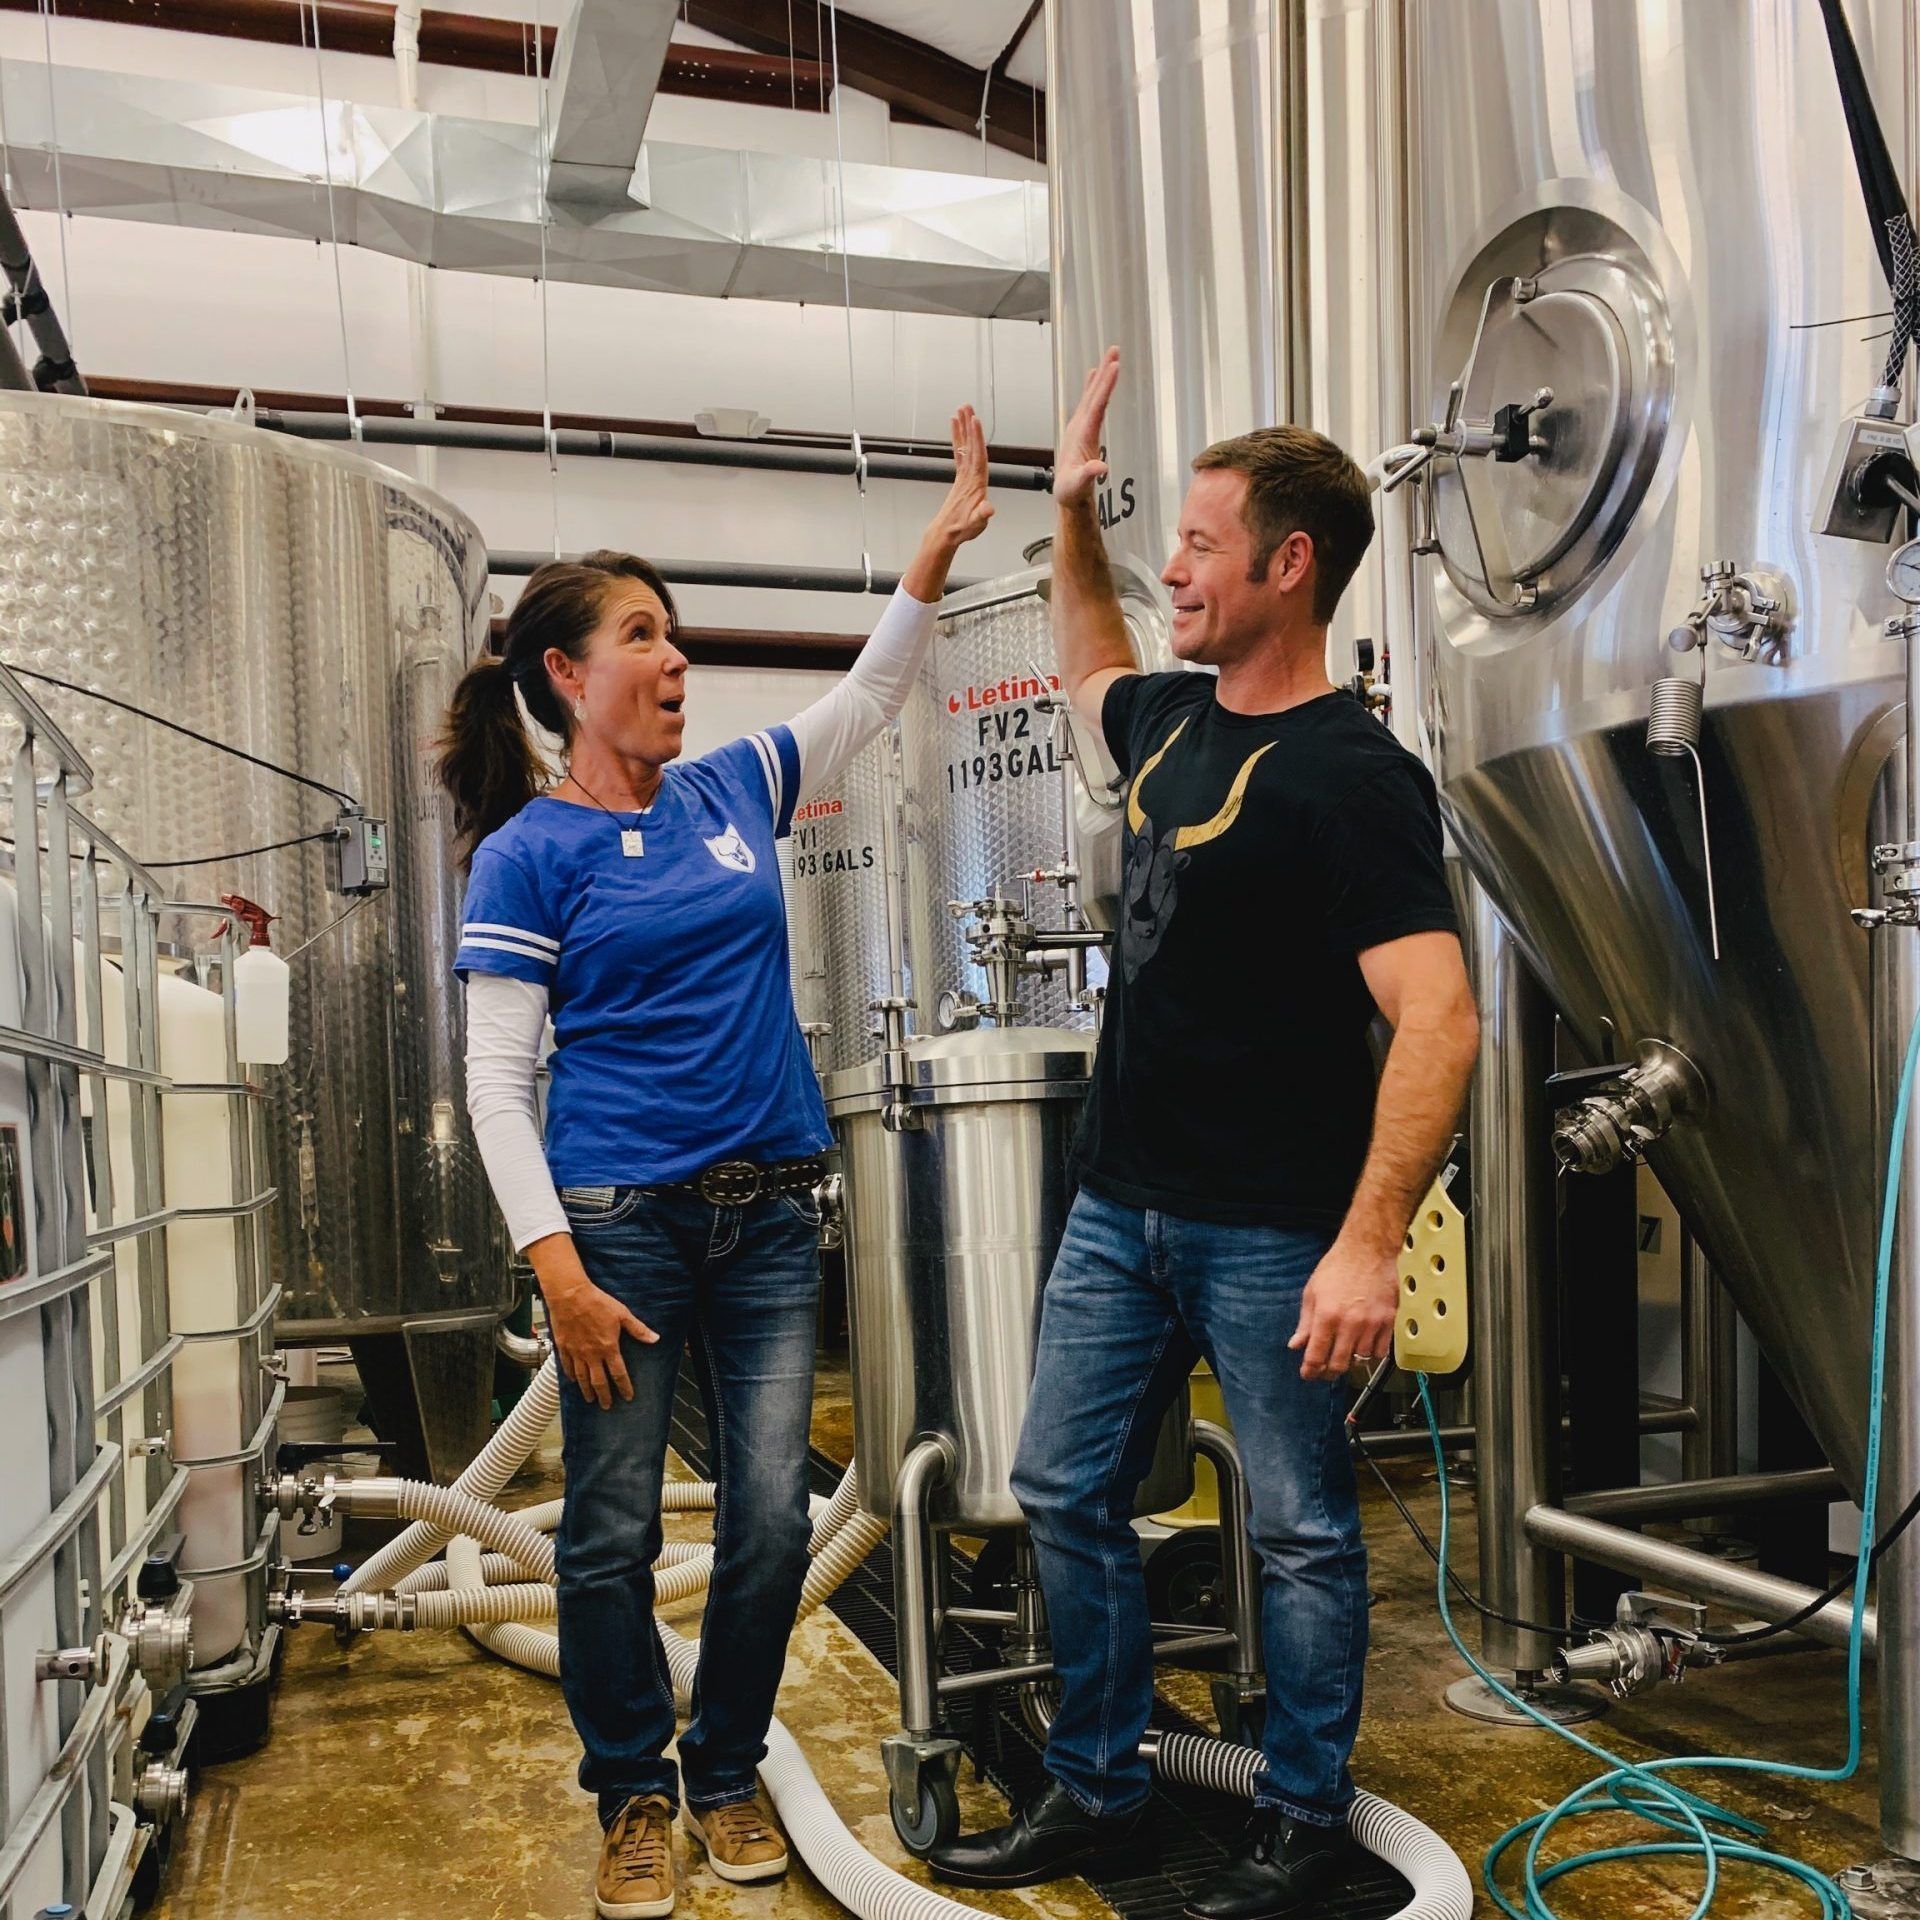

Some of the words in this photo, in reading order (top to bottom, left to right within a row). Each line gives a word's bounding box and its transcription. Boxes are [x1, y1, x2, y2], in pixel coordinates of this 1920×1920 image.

[1098, 477, 1136, 531] ALS
[967, 674, 1060, 711] Letina
[978, 707, 1031, 747] FV2
[795, 799, 843, 821] etina
[822, 846, 875, 873] GALS
